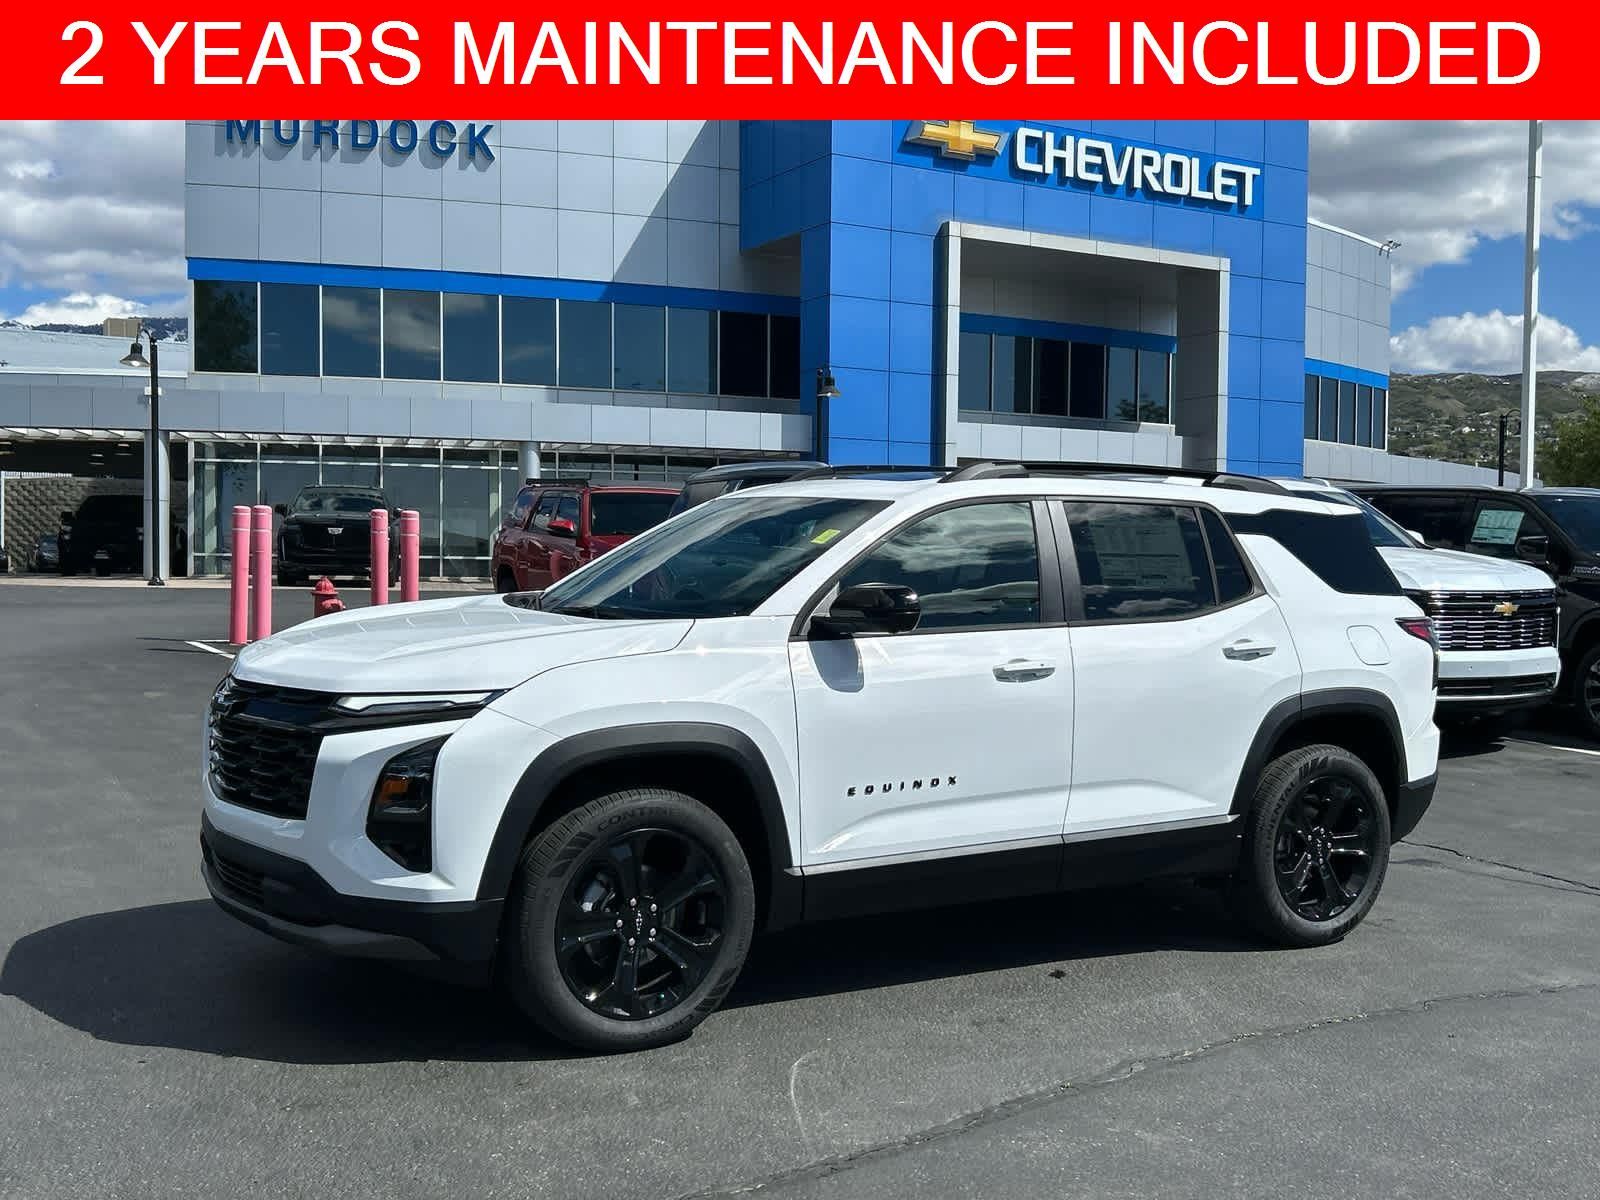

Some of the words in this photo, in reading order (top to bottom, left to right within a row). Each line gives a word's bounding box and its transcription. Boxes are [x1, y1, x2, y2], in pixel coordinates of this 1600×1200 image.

[225, 120, 495, 162] MURDOCK
[1016, 126, 1261, 206] CHEVROLET
[846, 775, 957, 797] EQUINOX
